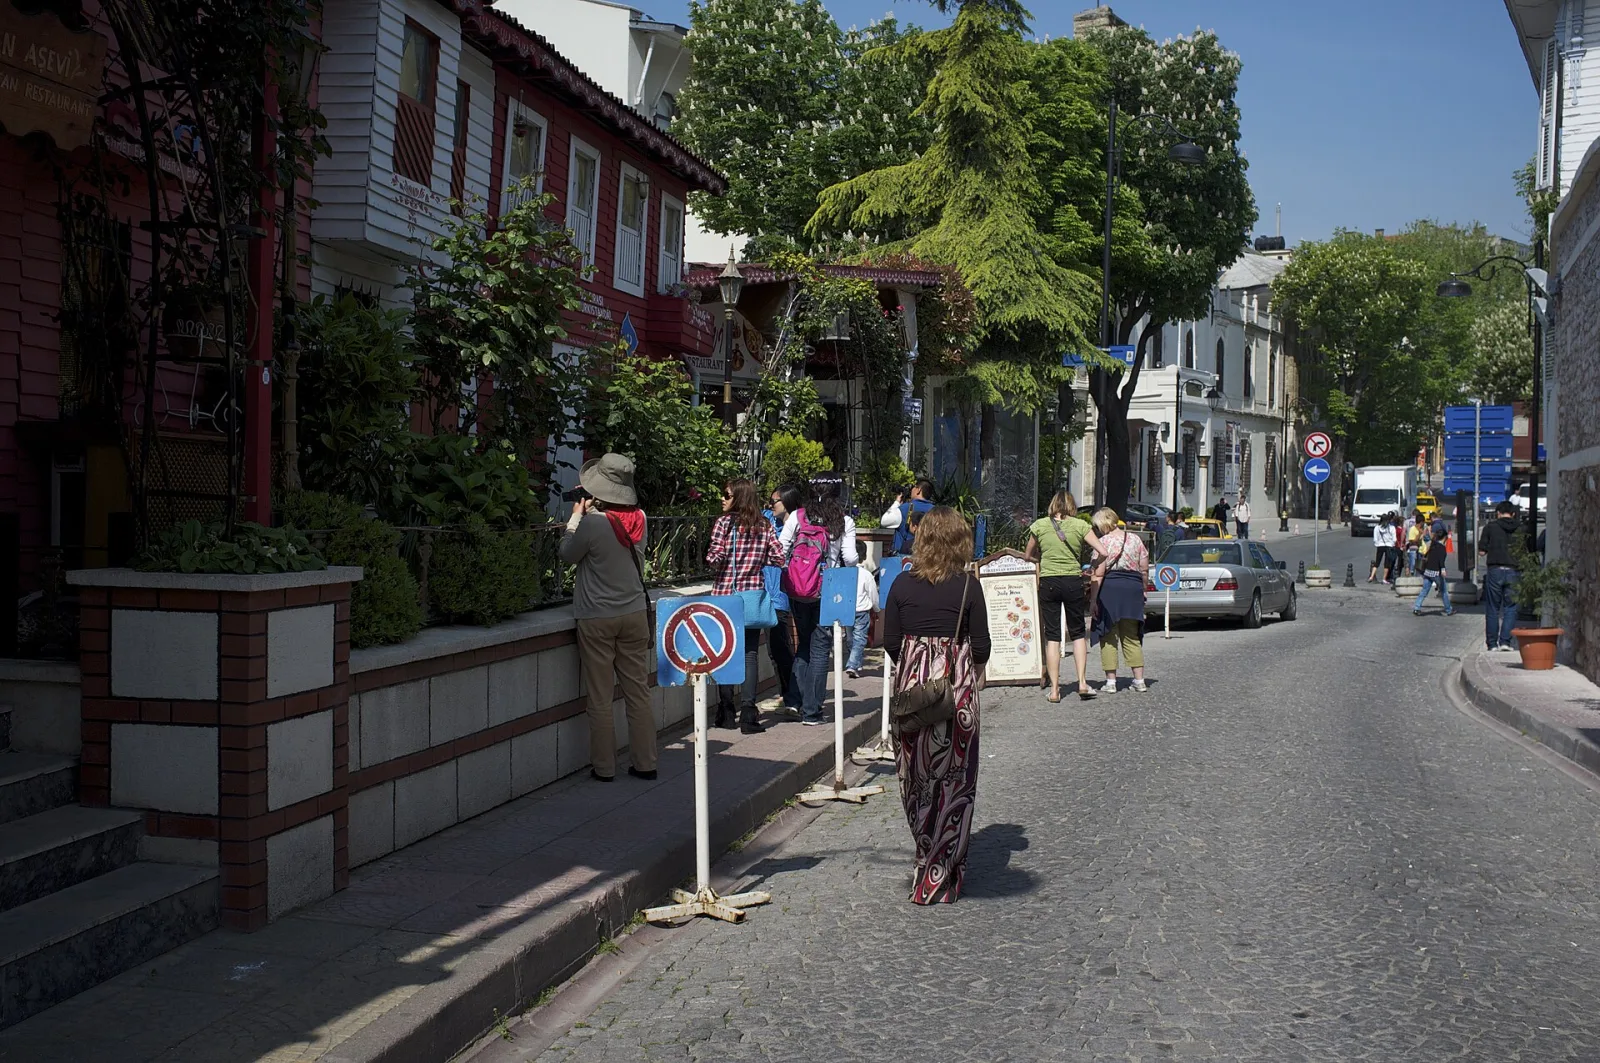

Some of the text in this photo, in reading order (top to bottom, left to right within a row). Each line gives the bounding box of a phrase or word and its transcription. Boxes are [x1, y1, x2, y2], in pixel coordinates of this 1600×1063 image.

[24, 43, 73, 78] AŞEVİ
[0, 73, 92, 117] AN RESTAURANT
